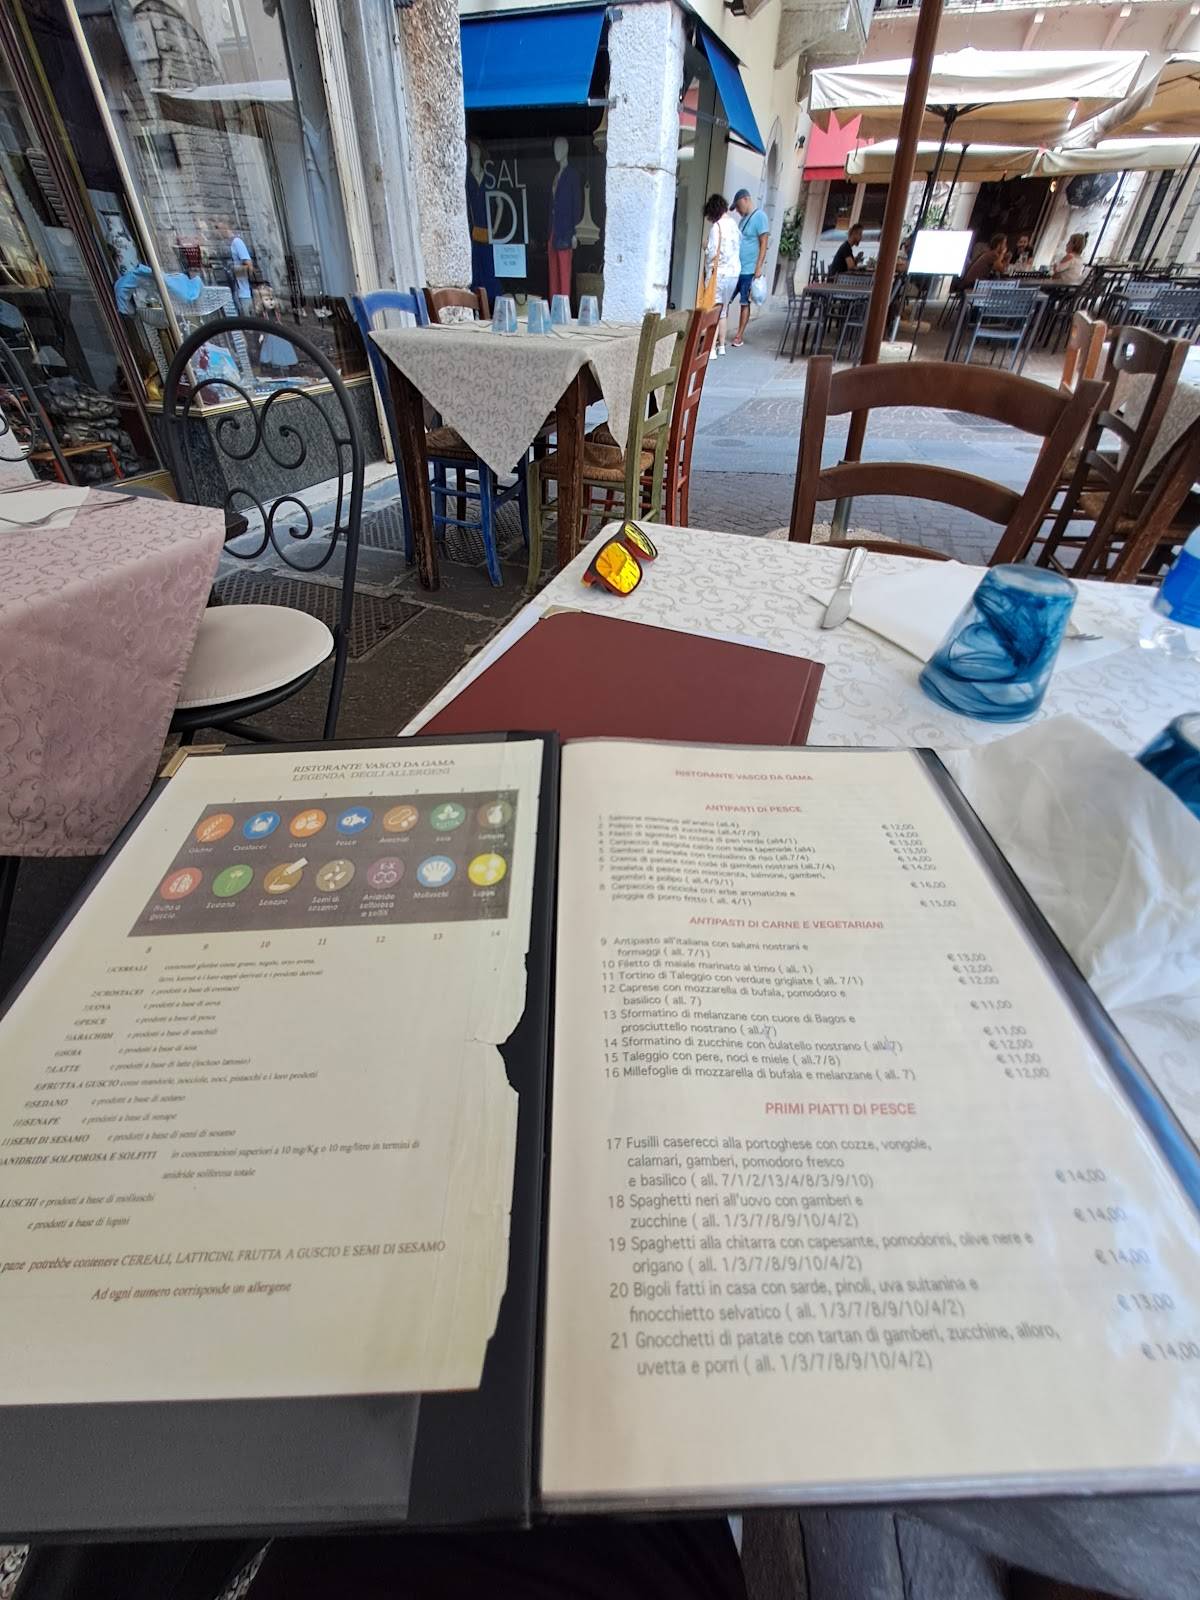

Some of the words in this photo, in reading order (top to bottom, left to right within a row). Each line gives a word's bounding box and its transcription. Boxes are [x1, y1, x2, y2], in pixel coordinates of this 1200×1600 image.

[483, 158, 526, 189] SAL
[485, 189, 528, 244] DI
[293, 764, 362, 773] RISTORANTE
[365, 762, 400, 770] VASCO
[403, 760, 418, 768] DA
[293, 771, 346, 782] LEGENDA
[676, 770, 734, 780] RISTORANTE
[736, 773, 768, 781] VASCO
[705, 804, 756, 813] ANTIPASTI
[770, 806, 802, 814] PESCE
[690, 916, 745, 928] ANTIPASTI
[748, 920, 759, 928] DI
[762, 920, 800, 929] CARNE
[802, 920, 810, 929] E
[812, 920, 884, 930] VEGETARIANI
[604, 1038, 617, 1048] 14
[622, 1036, 682, 1047] Sformatino
[685, 1036, 694, 1046] di
[698, 1038, 743, 1048] zucchine
[746, 1041, 766, 1049] con
[769, 1040, 812, 1050] culatello
[815, 1041, 862, 1050] nostrano
[604, 1053, 618, 1063] 15
[622, 1052, 669, 1063] Taleggio
[672, 1052, 692, 1061] con
[696, 1054, 723, 1064] pere,
[726, 1052, 748, 1062] noci
[762, 1055, 789, 1064] miele
[605, 1067, 620, 1078] 16
[624, 1065, 678, 1078] Millefoglie
[682, 1066, 692, 1076] di
[696, 1067, 754, 1078] mozzarella
[757, 1068, 766, 1078] di
[769, 1068, 803, 1079] bufala
[806, 1071, 812, 1080] e
[816, 1070, 872, 1080] melanzane
[765, 1102, 804, 1115] PRIMI
[809, 1103, 850, 1116] PIATTI
[854, 1103, 867, 1116] DI
[871, 1104, 916, 1116] PESCE
[607, 1137, 622, 1150] 17
[626, 1136, 660, 1148] Fusilli
[663, 1136, 719, 1148] caserecci
[722, 1136, 742, 1148] alla
[746, 1138, 812, 1152] portoghese
[816, 1140, 838, 1150] con
[841, 1140, 880, 1152] cozze,
[882, 1138, 932, 1152] vongole,
[628, 1154, 682, 1168] calamari,
[686, 1154, 738, 1169] gamberi,
[742, 1156, 803, 1169] pomodoro
[806, 1156, 844, 1168] fresco
[628, 1177, 636, 1188] e
[641, 1172, 687, 1186] basilico
[608, 1195, 625, 1209] 18
[630, 1193, 692, 1210] Spaghetti
[696, 1194, 720, 1206] neri
[724, 1192, 772, 1207] all'uovo
[775, 1196, 798, 1207] con
[802, 1194, 850, 1209] gamberi
[856, 1196, 864, 1206] e
[630, 1213, 688, 1229] zucchine
[609, 1237, 626, 1251] 19
[631, 1235, 696, 1253] Spaghetti
[700, 1236, 722, 1249] alla
[726, 1236, 776, 1249] chitarra
[780, 1238, 804, 1249] con
[808, 1235, 880, 1250] capesante,
[960, 1232, 990, 1246] olive
[992, 1234, 1020, 1244] nere
[1024, 1233, 1034, 1244] e
[28, 1258, 72, 1272] potrebbe
[73, 1257, 120, 1268] contenere
[122, 1253, 172, 1266] CEREALI,
[176, 1251, 234, 1264] LATTICINI,
[237, 1249, 282, 1262] FRUTTA
[284, 1248, 295, 1260] A
[297, 1247, 340, 1259] GUSCIO
[342, 1246, 350, 1257] E
[352, 1245, 380, 1257] SEMI
[382, 1244, 396, 1255] DI
[398, 1240, 446, 1254] SESAMO
[632, 1258, 683, 1276] origano
[92, 1288, 108, 1300] Ad
[109, 1287, 130, 1302] ogni
[134, 1287, 170, 1299] numero
[173, 1283, 228, 1298] corrisponde
[232, 1284, 245, 1294] un
[247, 1282, 292, 1296] allergene
[610, 1282, 629, 1298] 20
[634, 1280, 671, 1300] Bigoli
[676, 1280, 705, 1296] fatti
[710, 1281, 721, 1296] in
[726, 1284, 756, 1296] casa
[762, 1283, 786, 1294] con
[790, 1280, 832, 1296] sarde,
[836, 1277, 876, 1296] pinoli,
[880, 1280, 904, 1292] uva
[970, 1278, 978, 1291] e
[630, 1305, 714, 1322] finocchietto
[720, 1305, 782, 1320] selvatico
[611, 1332, 628, 1349] 21
[635, 1330, 714, 1349] Gnocchetti
[720, 1330, 732, 1346] di
[738, 1331, 783, 1348] patate
[788, 1332, 814, 1344] con
[818, 1329, 862, 1344] tartan
[866, 1326, 880, 1343] di
[883, 1325, 944, 1346] gamberi,
[948, 1322, 1014, 1342] zucchine,
[636, 1359, 686, 1376] uvetta
[692, 1361, 700, 1374] e
[705, 1357, 740, 1376] porri
